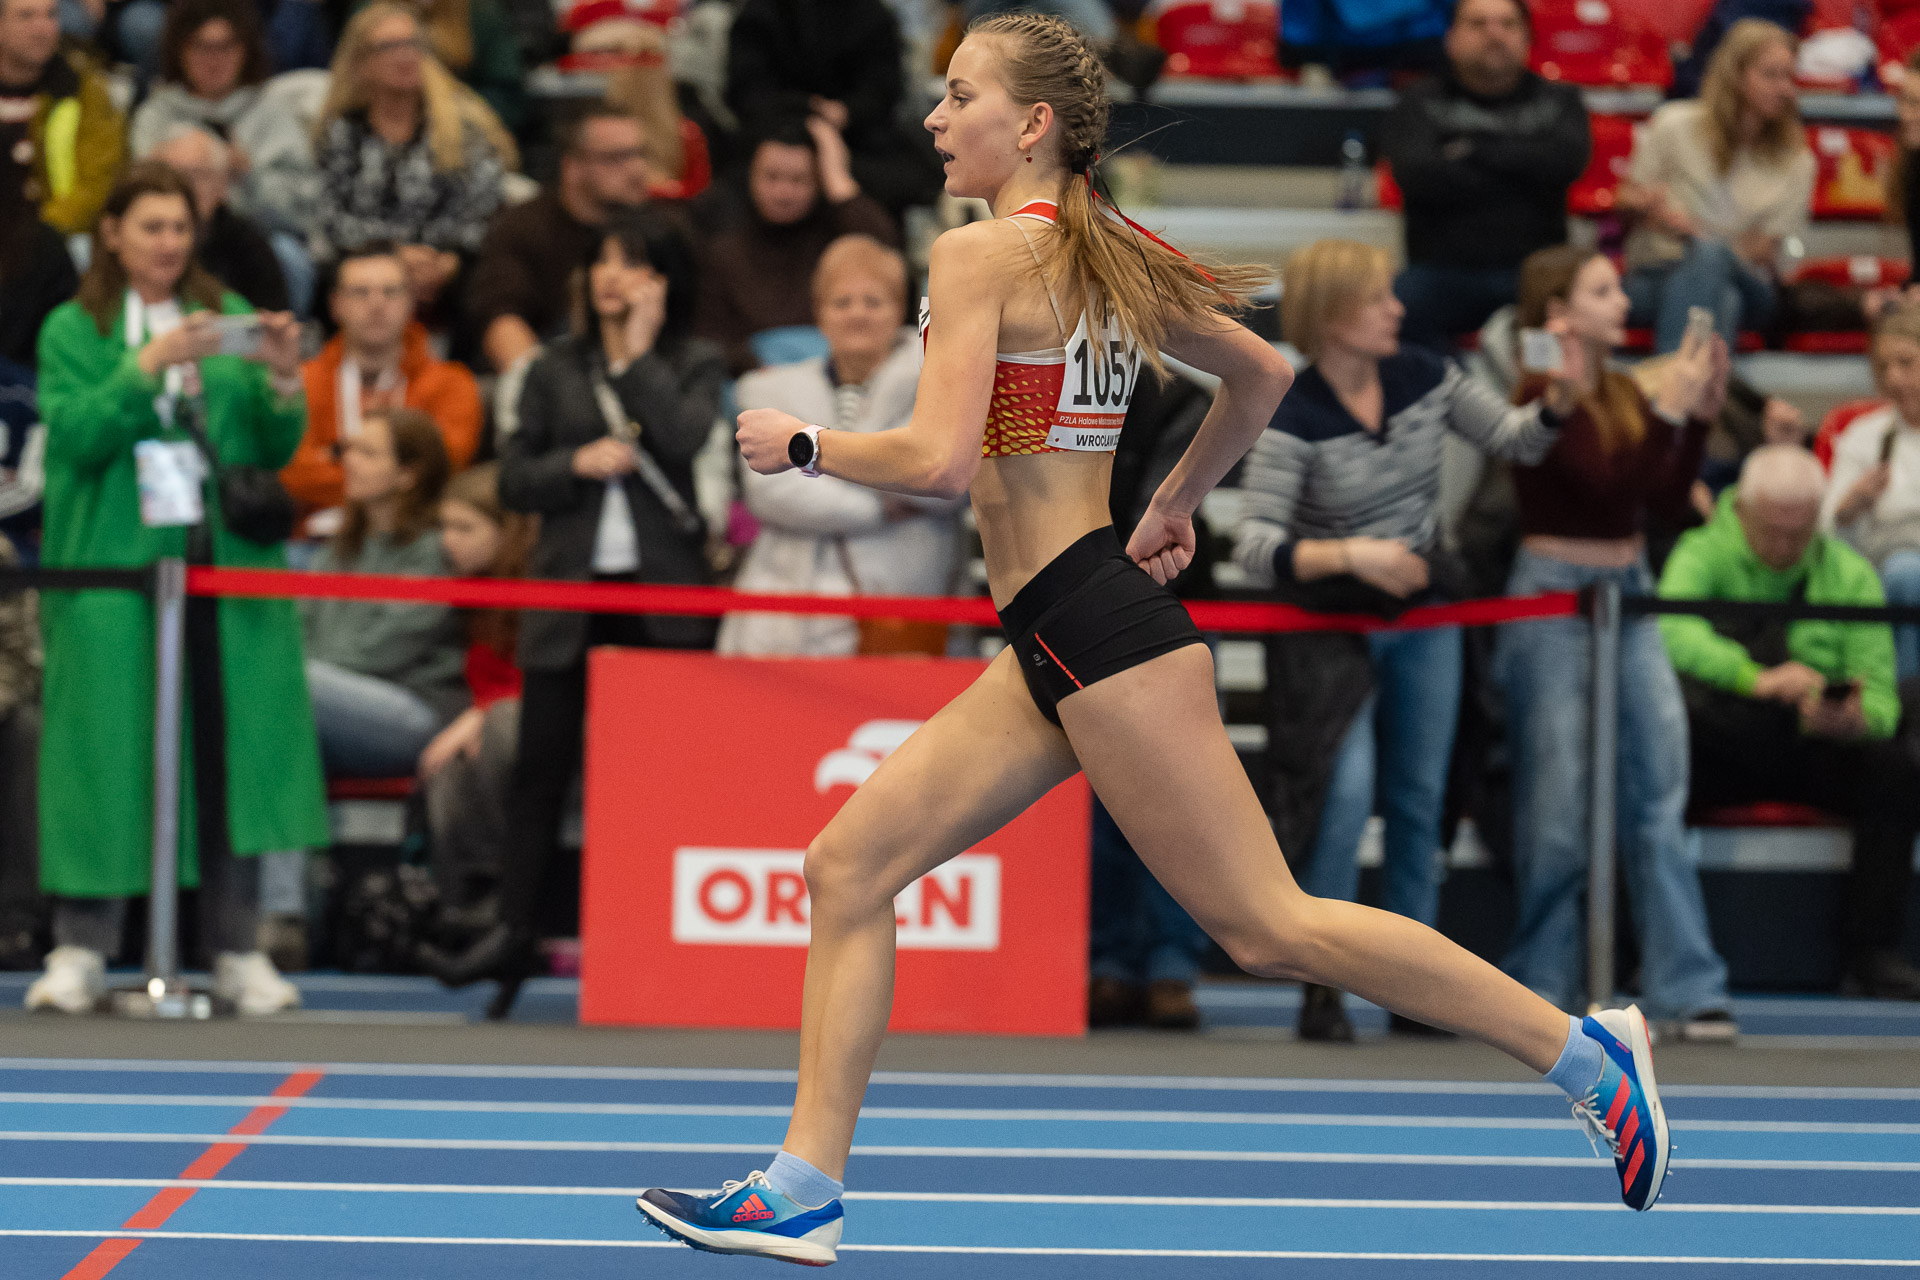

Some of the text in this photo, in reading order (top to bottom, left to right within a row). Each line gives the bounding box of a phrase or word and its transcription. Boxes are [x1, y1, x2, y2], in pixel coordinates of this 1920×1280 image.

[1059, 415, 1077, 425] PZLA
[698, 869, 972, 928] ORN
[732, 1210, 775, 1223] adidas
